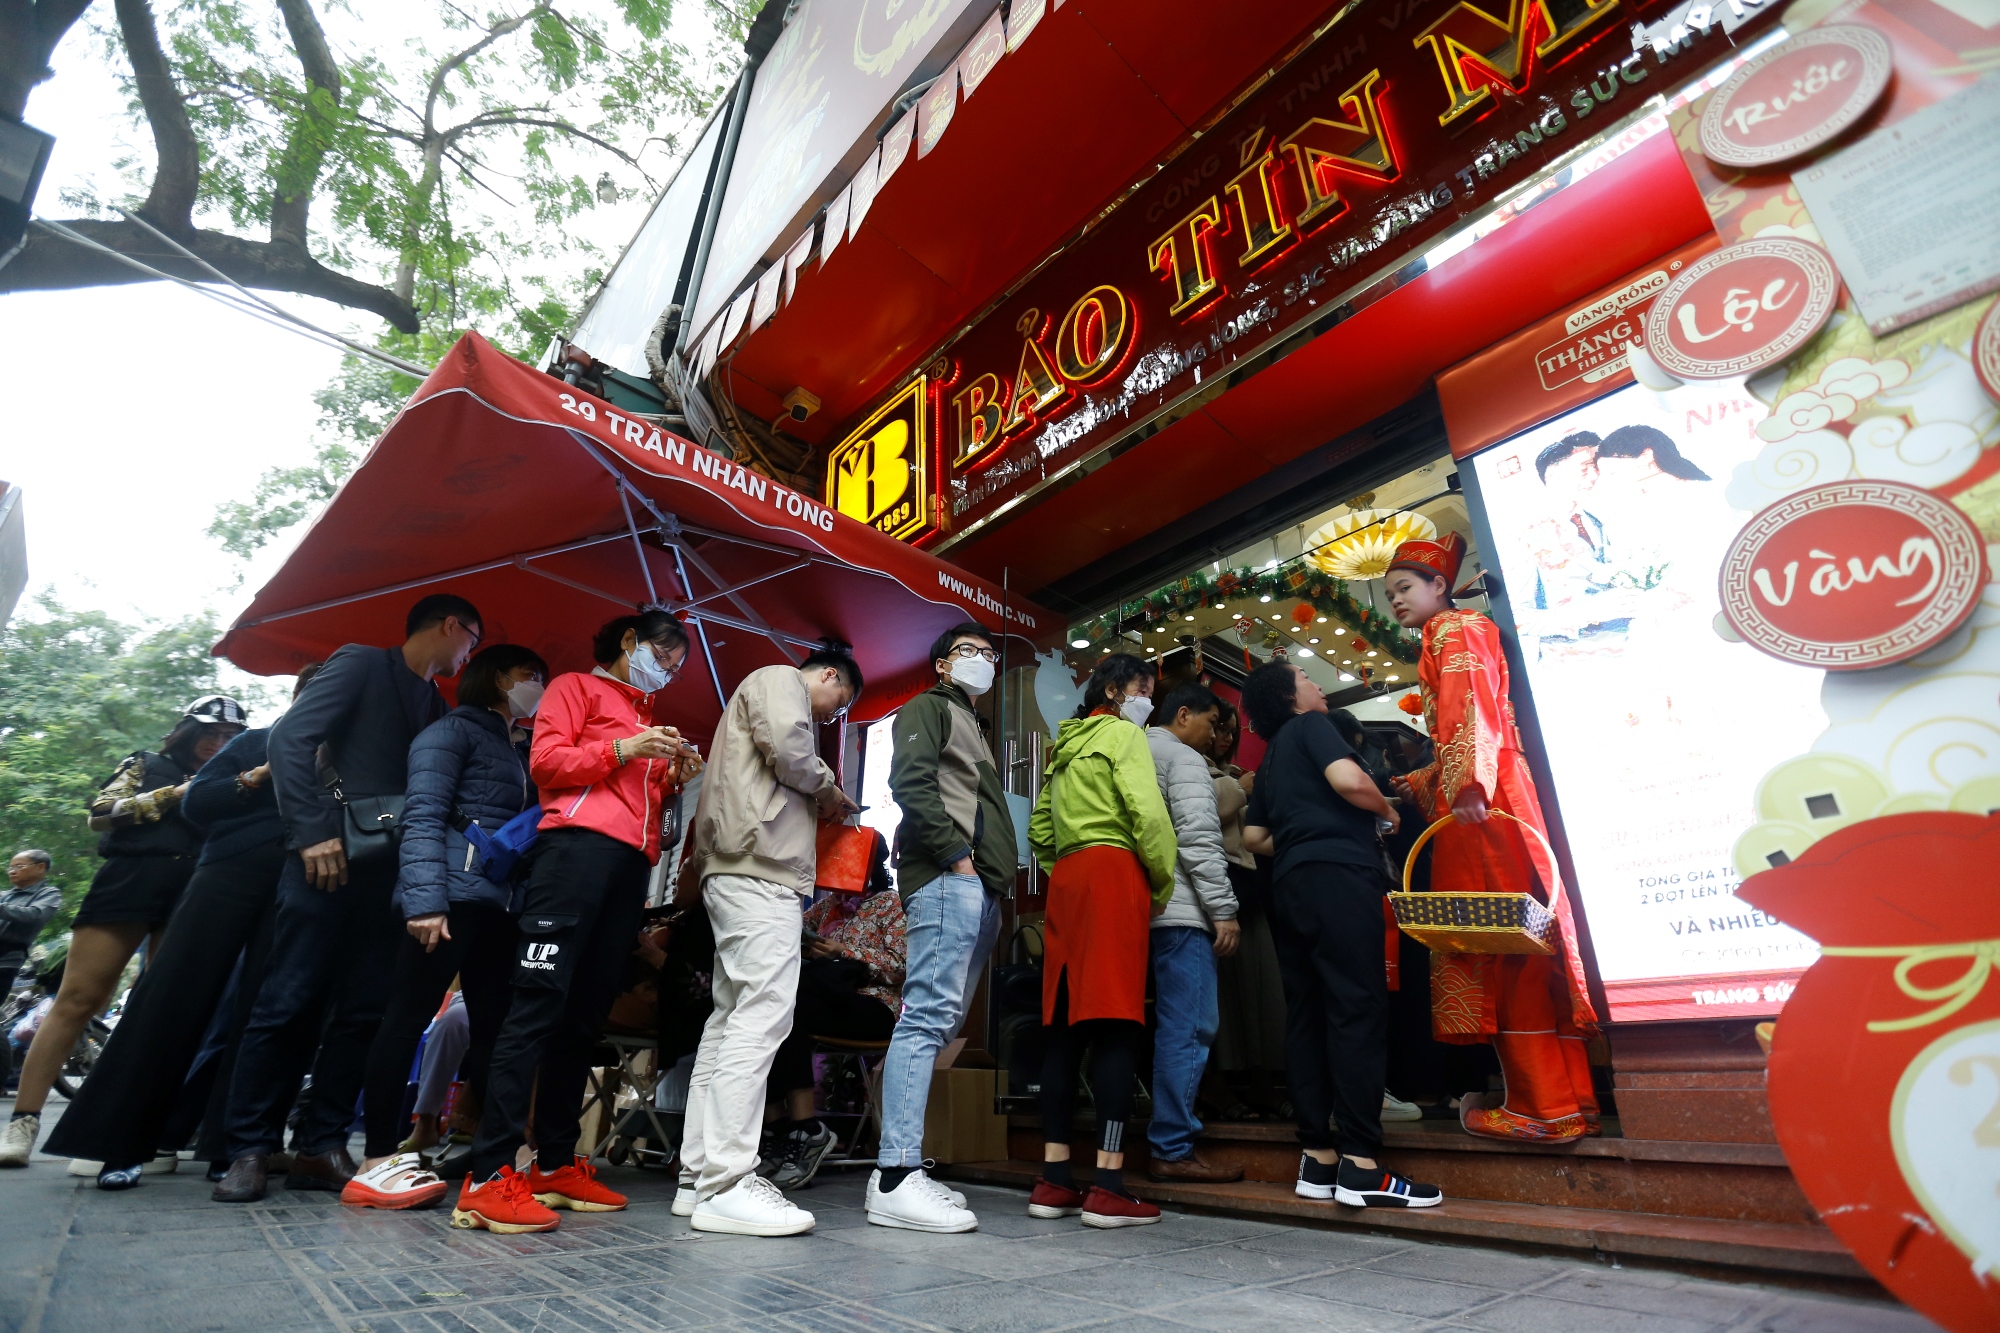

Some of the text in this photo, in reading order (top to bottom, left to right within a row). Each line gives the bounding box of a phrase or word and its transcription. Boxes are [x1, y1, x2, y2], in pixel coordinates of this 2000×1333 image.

[1278, 34, 1367, 113] TNHH
[1455, 105, 1568, 192] TRANG
[952, 285, 1127, 469] BẢO
[1148, 68, 1392, 317] TÍN
[1570, 301, 1614, 328] VÀNG
[1616, 276, 1664, 305] RỒNG
[1677, 278, 1799, 343] Lộc
[1541, 321, 1633, 374] THĂNG
[1577, 334, 1642, 371] FINE GOD
[558, 393, 835, 532] 29 TRẦN NHÂN TÔNG
[875, 501, 910, 533] 1989
[1753, 536, 1941, 608] Vàng
[938, 570, 1036, 629] www.btmc.vn
[1641, 894, 1649, 905] 2
[1669, 915, 1702, 936] VÀ
[526, 942, 560, 962] UP
[1692, 987, 1760, 1006] TRANG
